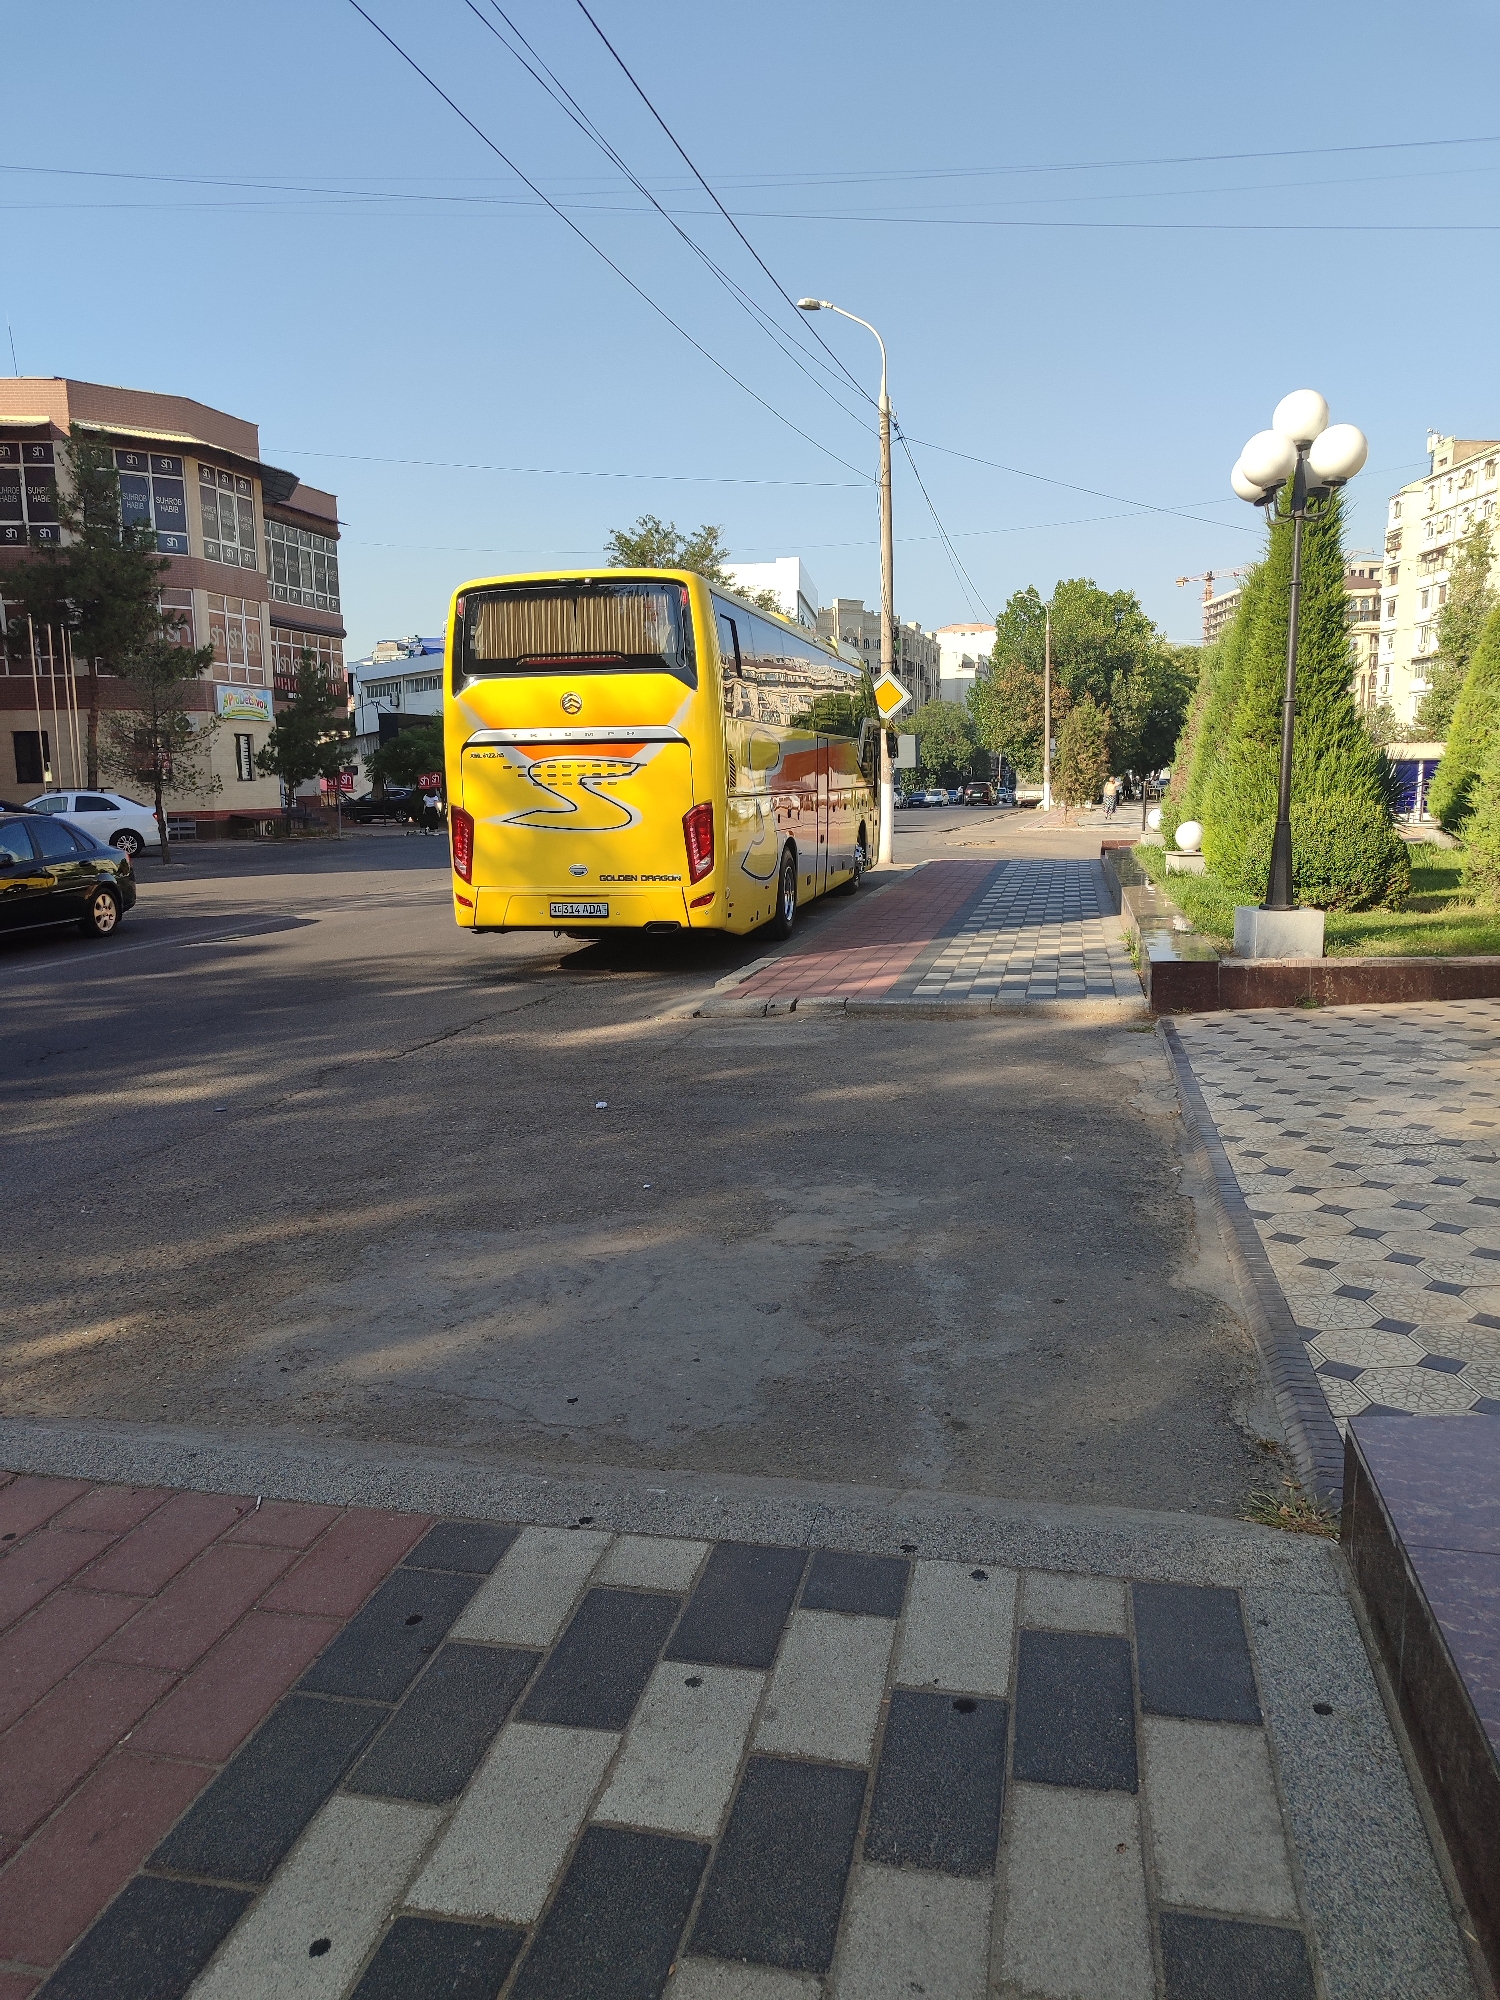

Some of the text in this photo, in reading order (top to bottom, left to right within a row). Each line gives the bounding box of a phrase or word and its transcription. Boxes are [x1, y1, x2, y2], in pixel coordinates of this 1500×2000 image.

[33, 446, 45, 457] sh
[127, 454, 139, 465] sh
[161, 458, 173, 469] sh
[122, 493, 147, 502] SUHROB
[156, 497, 183, 506] SUHROB
[127, 502, 145, 510] HABIB
[161, 505, 180, 513] HABIB
[6, 528, 18, 539] sh
[40, 528, 52, 538] sh
[167, 537, 178, 548] sh
[211, 625, 226, 647] sh
[229, 627, 243, 650] sh
[247, 630, 261, 652] sh
[280, 654, 291, 673] sh
[340, 774, 352, 785] sh
[420, 776, 430, 786] sh
[431, 773, 440, 783] sh
[563, 904, 581, 914] 314
[582, 904, 602, 914] ADA
